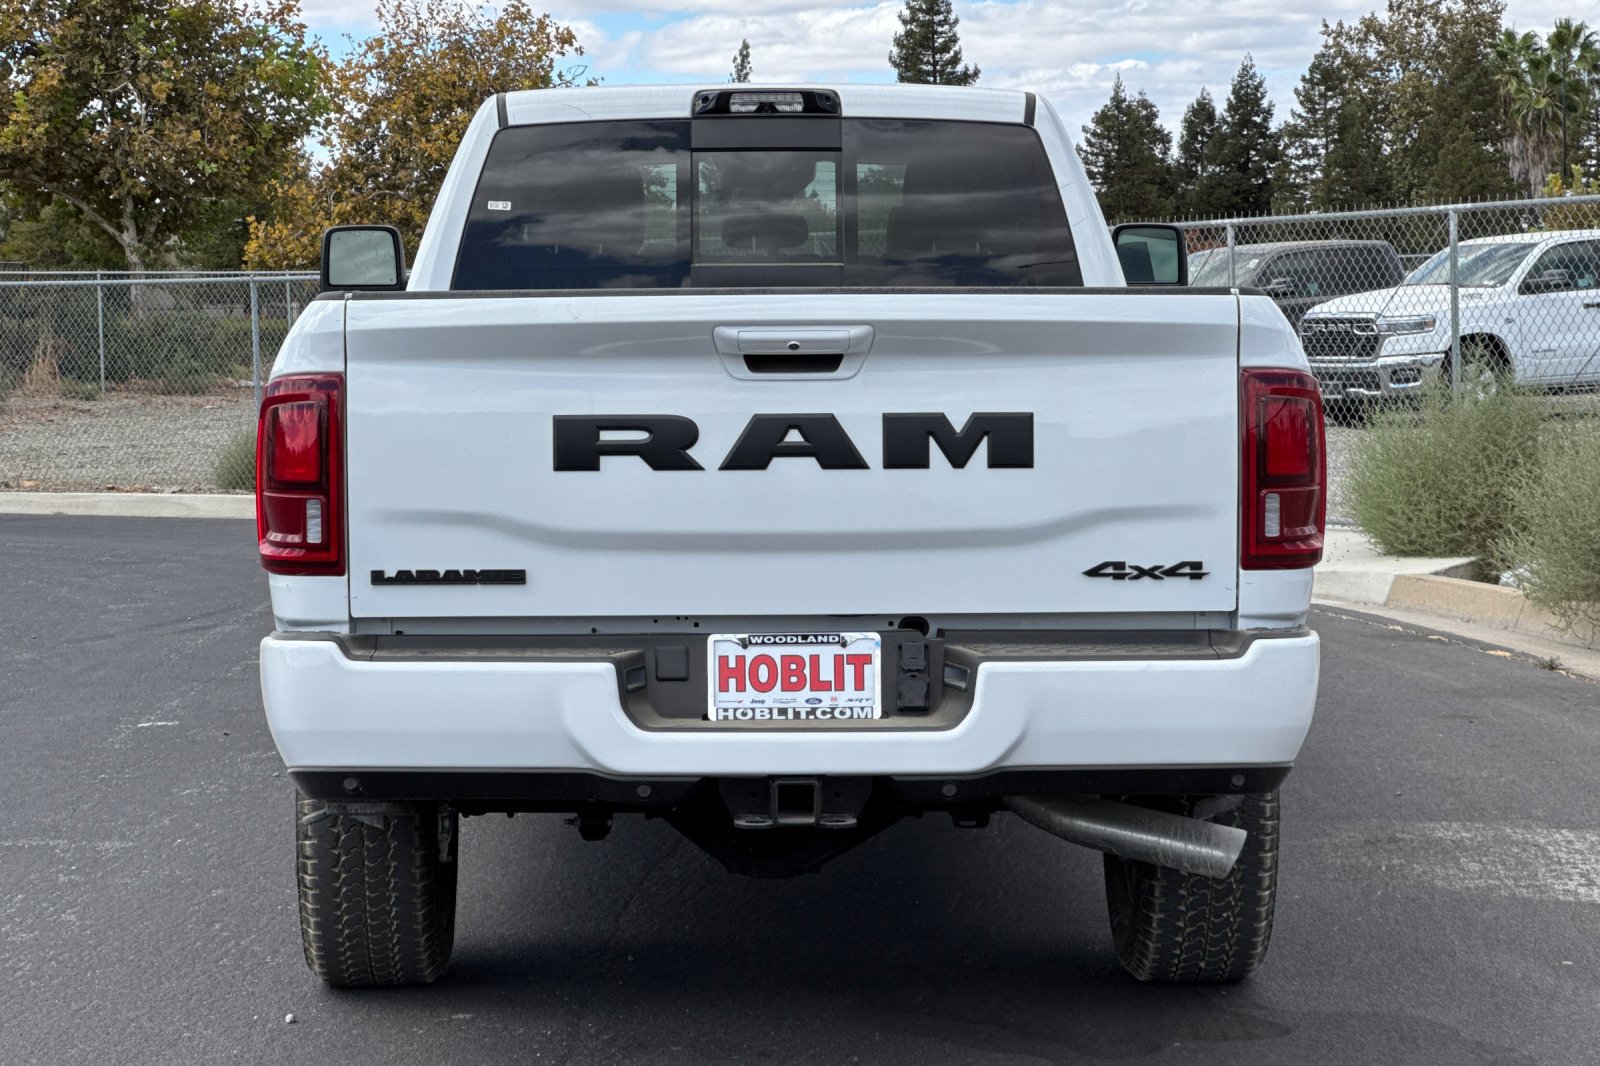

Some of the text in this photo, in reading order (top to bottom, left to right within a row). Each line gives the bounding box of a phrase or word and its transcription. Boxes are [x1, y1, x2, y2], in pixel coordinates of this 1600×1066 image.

[553, 412, 1034, 471] RAM
[1081, 561, 1210, 581] 4x4
[749, 635, 840, 644] WOODLAND
[718, 653, 872, 692] HOBLIT
[717, 707, 872, 720] HOBLIT.COM
